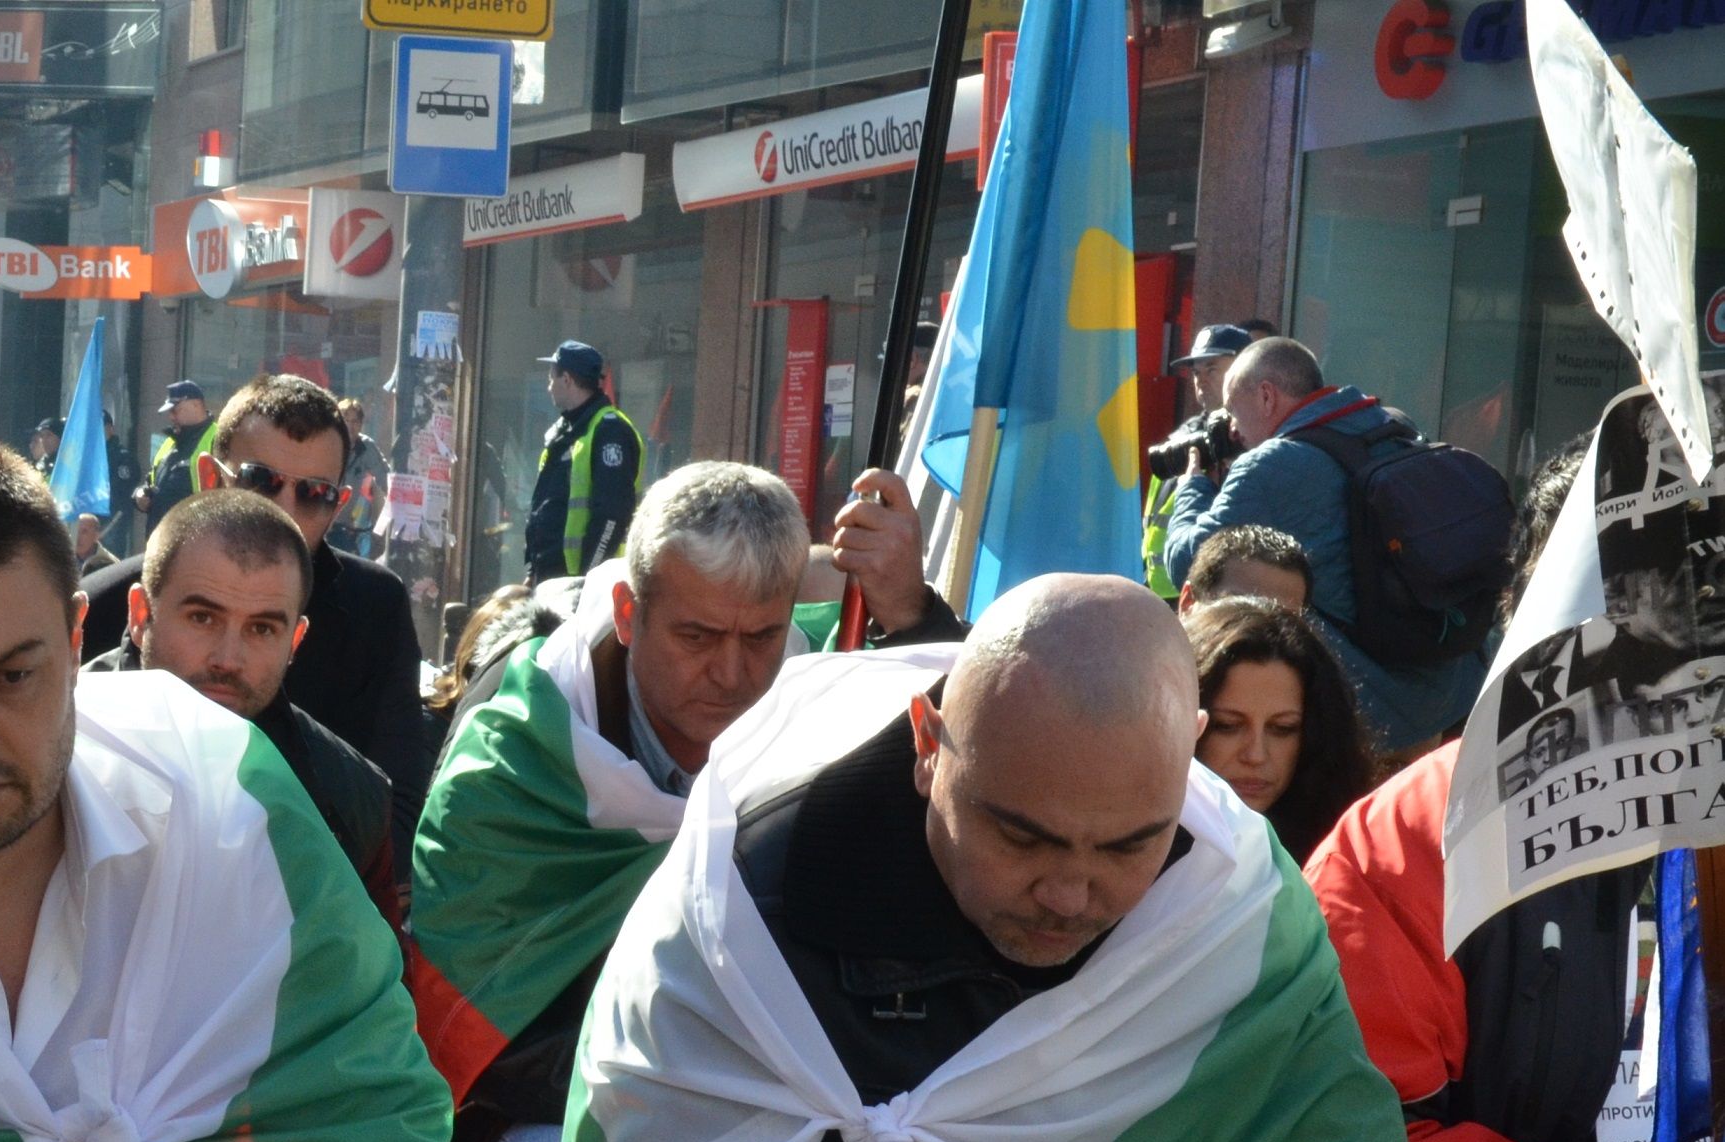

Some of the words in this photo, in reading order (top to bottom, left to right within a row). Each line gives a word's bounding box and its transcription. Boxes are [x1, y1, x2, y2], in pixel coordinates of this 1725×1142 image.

[386, 0, 527, 14] ркирането
[782, 125, 860, 175] UniCredit
[861, 116, 923, 159] Bulban
[467, 193, 522, 232] UniCredit
[522, 183, 576, 223] Bulbank
[196, 225, 230, 276] TBI
[242, 215, 300, 268] Bank
[59, 255, 132, 280] Bank
[1595, 498, 1638, 519] Кири
[1601, 1105, 1655, 1121] ПРОТИ
